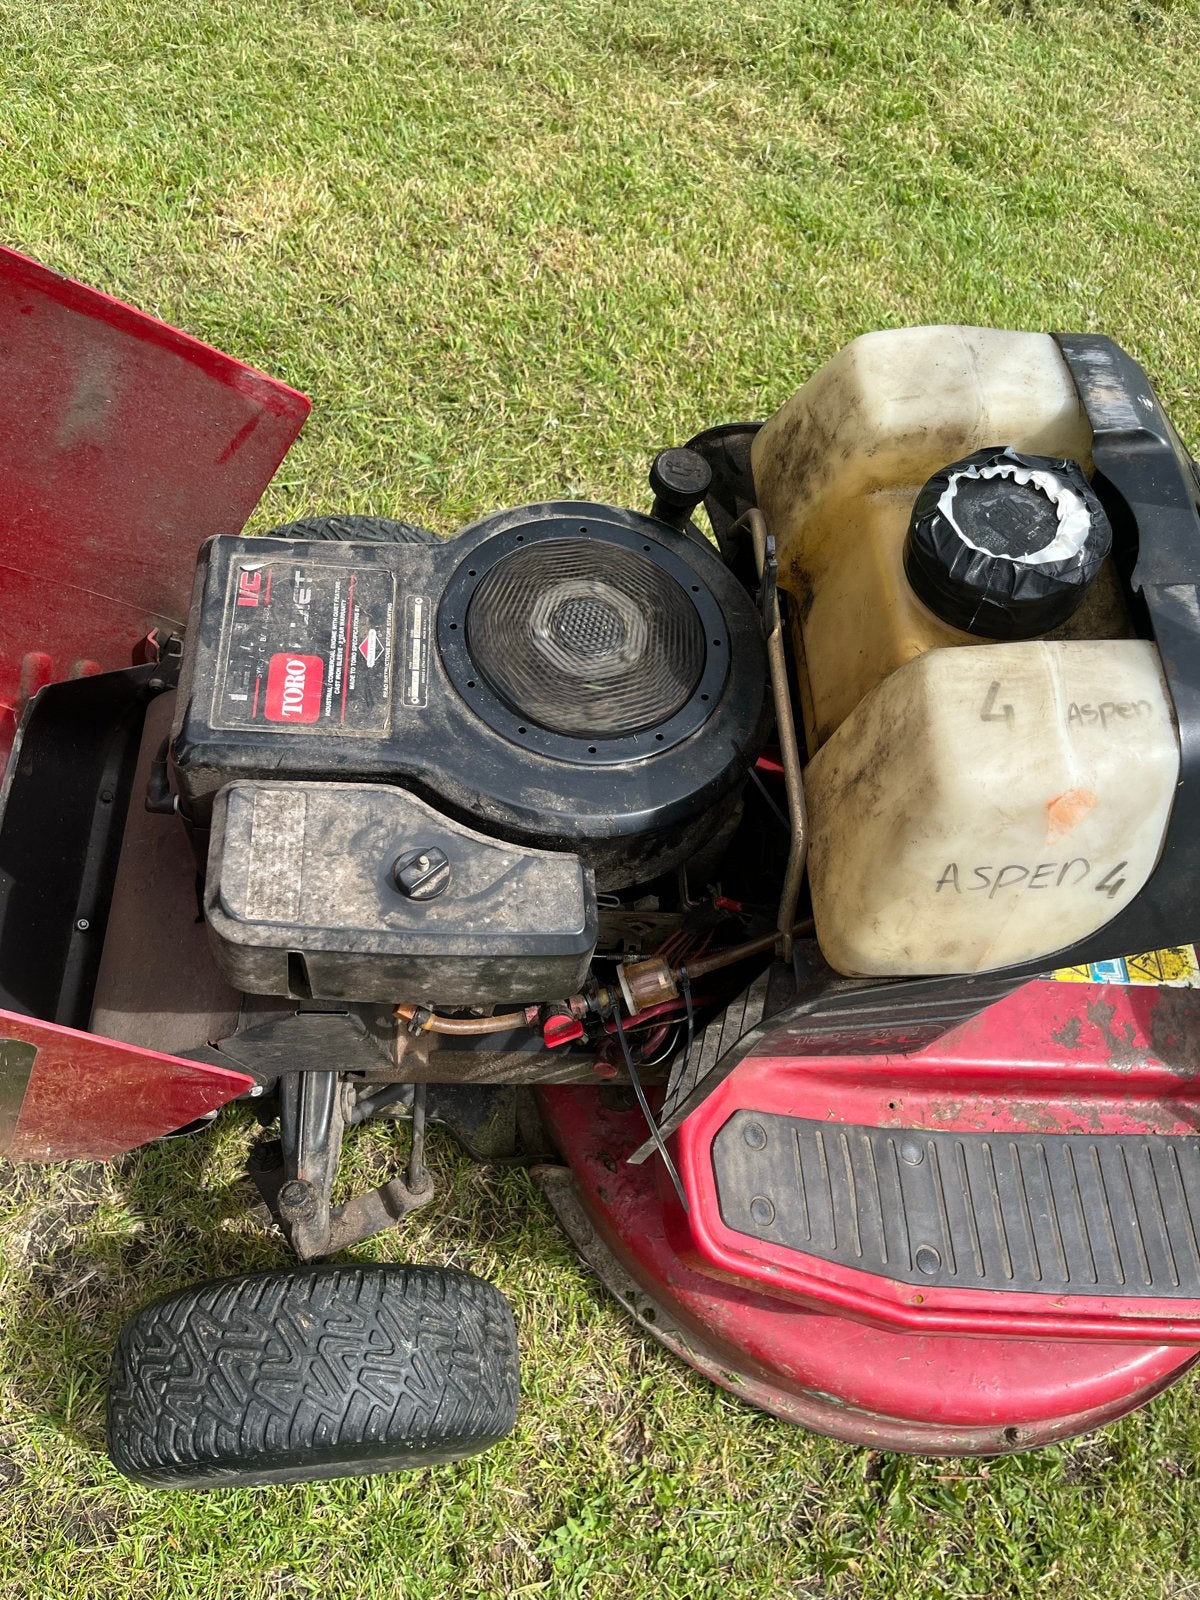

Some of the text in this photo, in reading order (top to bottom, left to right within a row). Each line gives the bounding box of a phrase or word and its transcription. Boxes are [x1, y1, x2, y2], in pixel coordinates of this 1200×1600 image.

[237, 571, 262, 607] I/C
[351, 613, 360, 652] SPECIFICATIONS
[327, 650, 336, 683] COMMERCIAL
[281, 659, 307, 716] TORO
[325, 687, 333, 717] INDUSTRIAL
[980, 681, 1015, 726] 4
[1067, 700, 1153, 731] Aspen
[1095, 861, 1128, 899] 4
